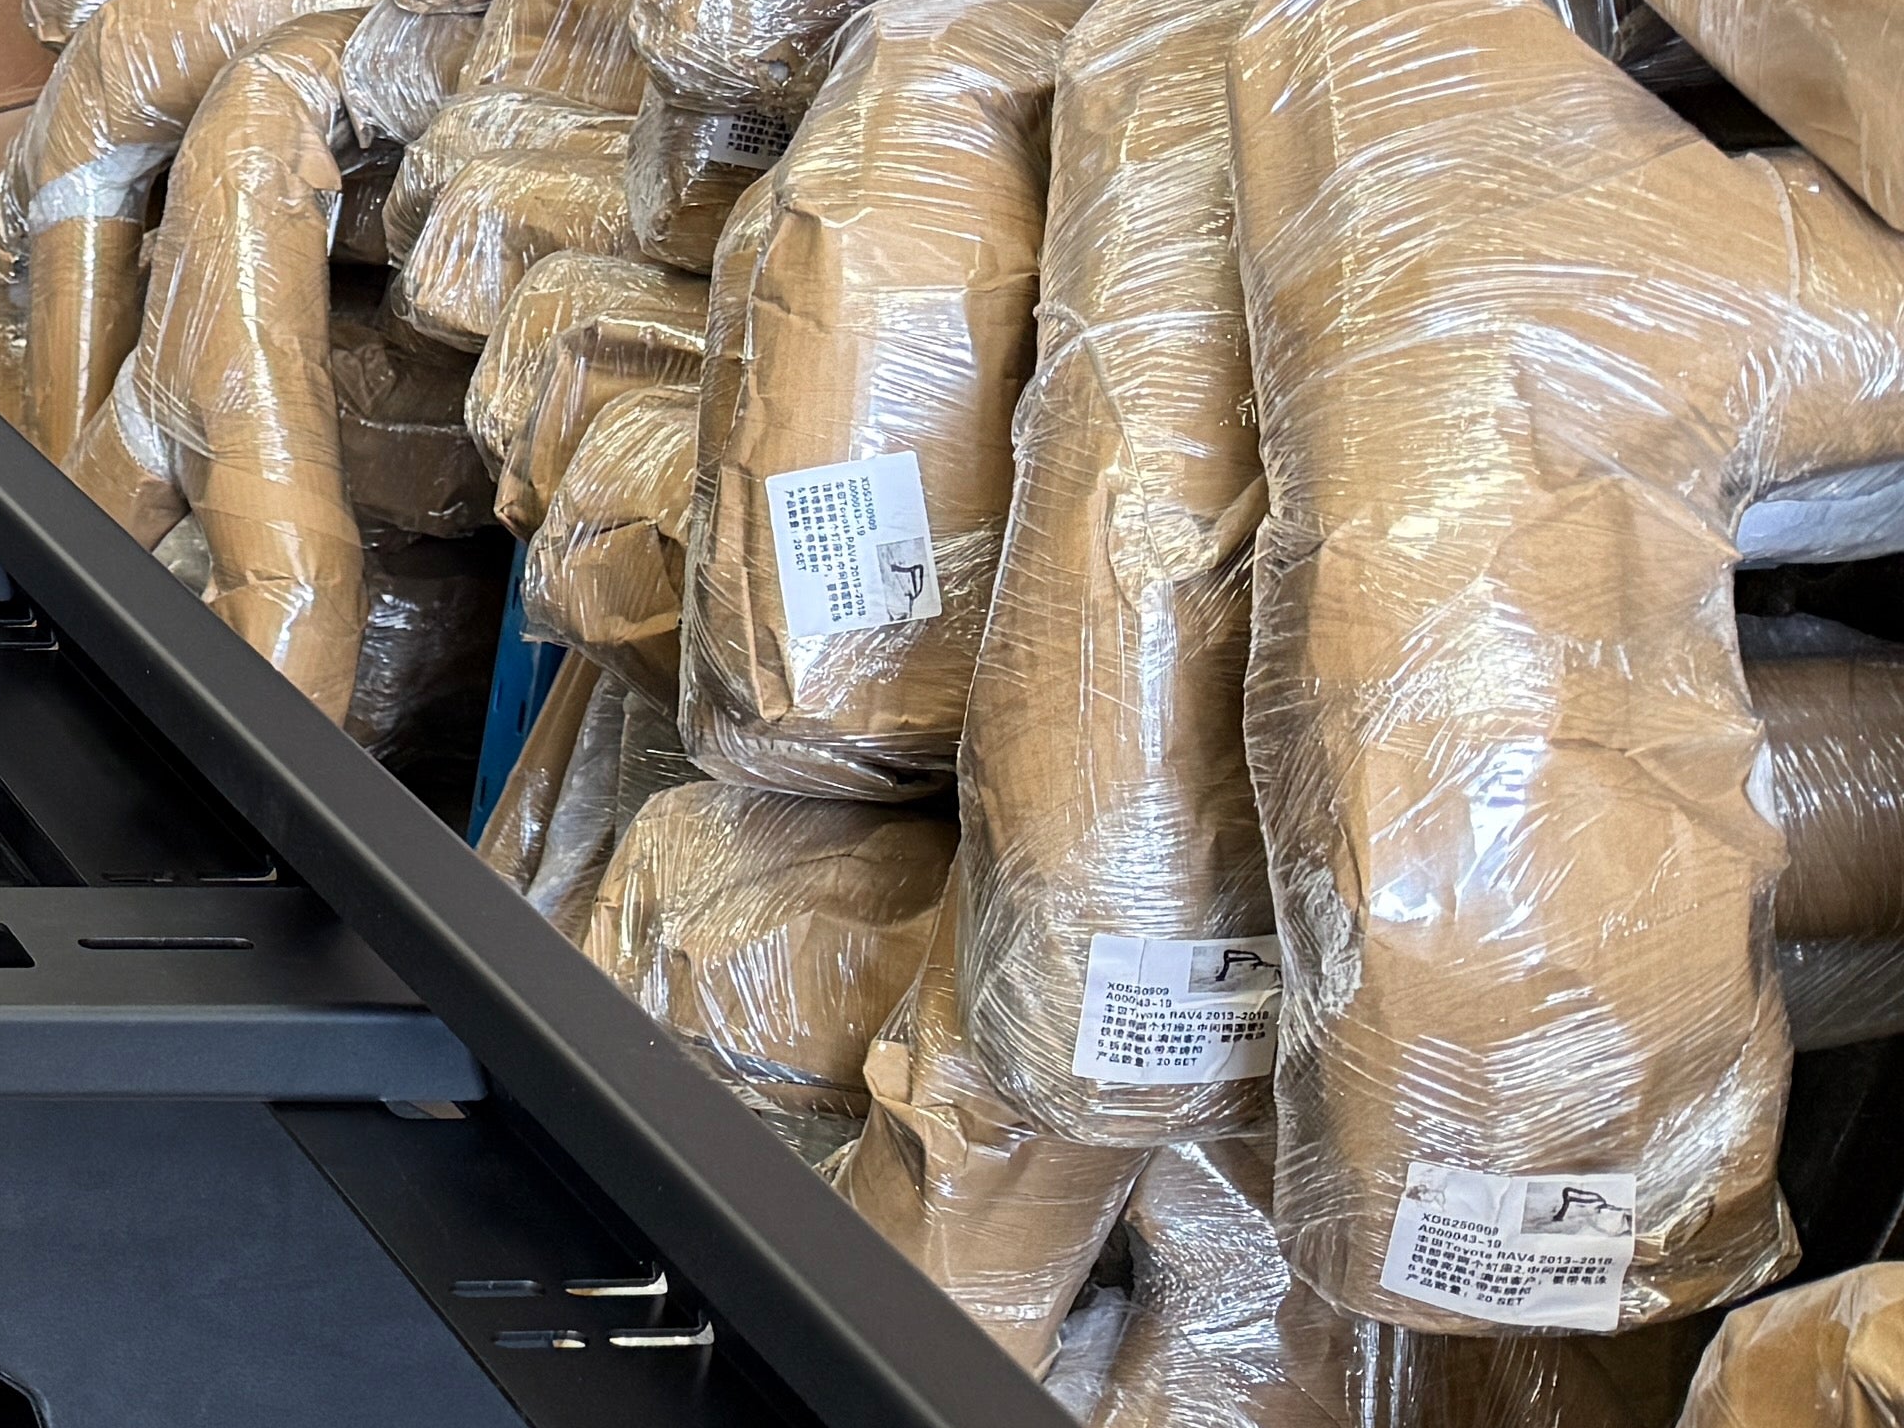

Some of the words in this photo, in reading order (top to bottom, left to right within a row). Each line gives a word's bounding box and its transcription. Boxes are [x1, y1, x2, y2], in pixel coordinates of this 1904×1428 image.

[845, 536, 857, 564] RAV4
[1169, 1011, 1202, 1019] RAV4
[1157, 1058, 1170, 1066] 20
[1174, 1058, 1198, 1066] SET
[1496, 1251, 1536, 1264] RAV4
[1476, 1293, 1493, 1303] 20
[1497, 1296, 1524, 1306] SET
